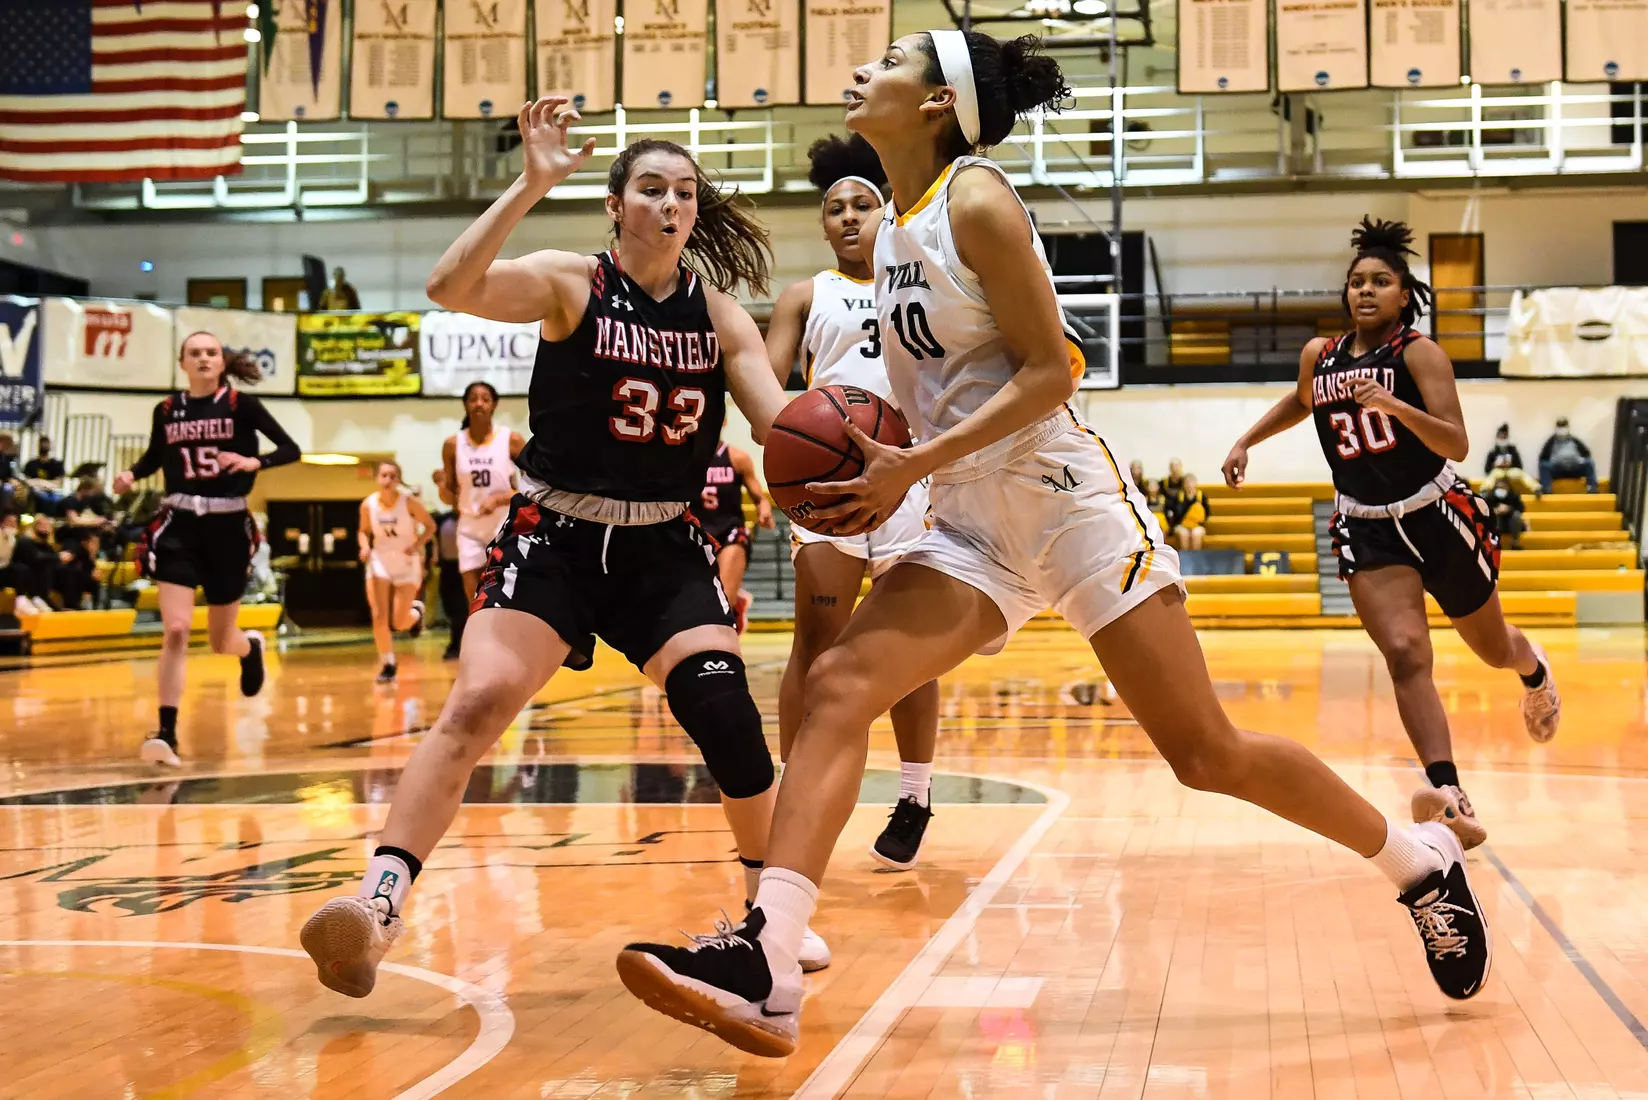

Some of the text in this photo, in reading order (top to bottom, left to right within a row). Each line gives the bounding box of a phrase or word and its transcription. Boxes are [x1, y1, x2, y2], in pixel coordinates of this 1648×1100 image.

[428, 332, 536, 364] UPMC
[593, 315, 719, 373] MANSFIELD
[860, 318, 881, 359] 3
[890, 301, 946, 360] 10
[164, 417, 235, 445] MANSFIELD
[608, 376, 706, 446] 33
[1329, 407, 1397, 460] 30
[179, 446, 220, 480] 15
[470, 469, 491, 488] 20
